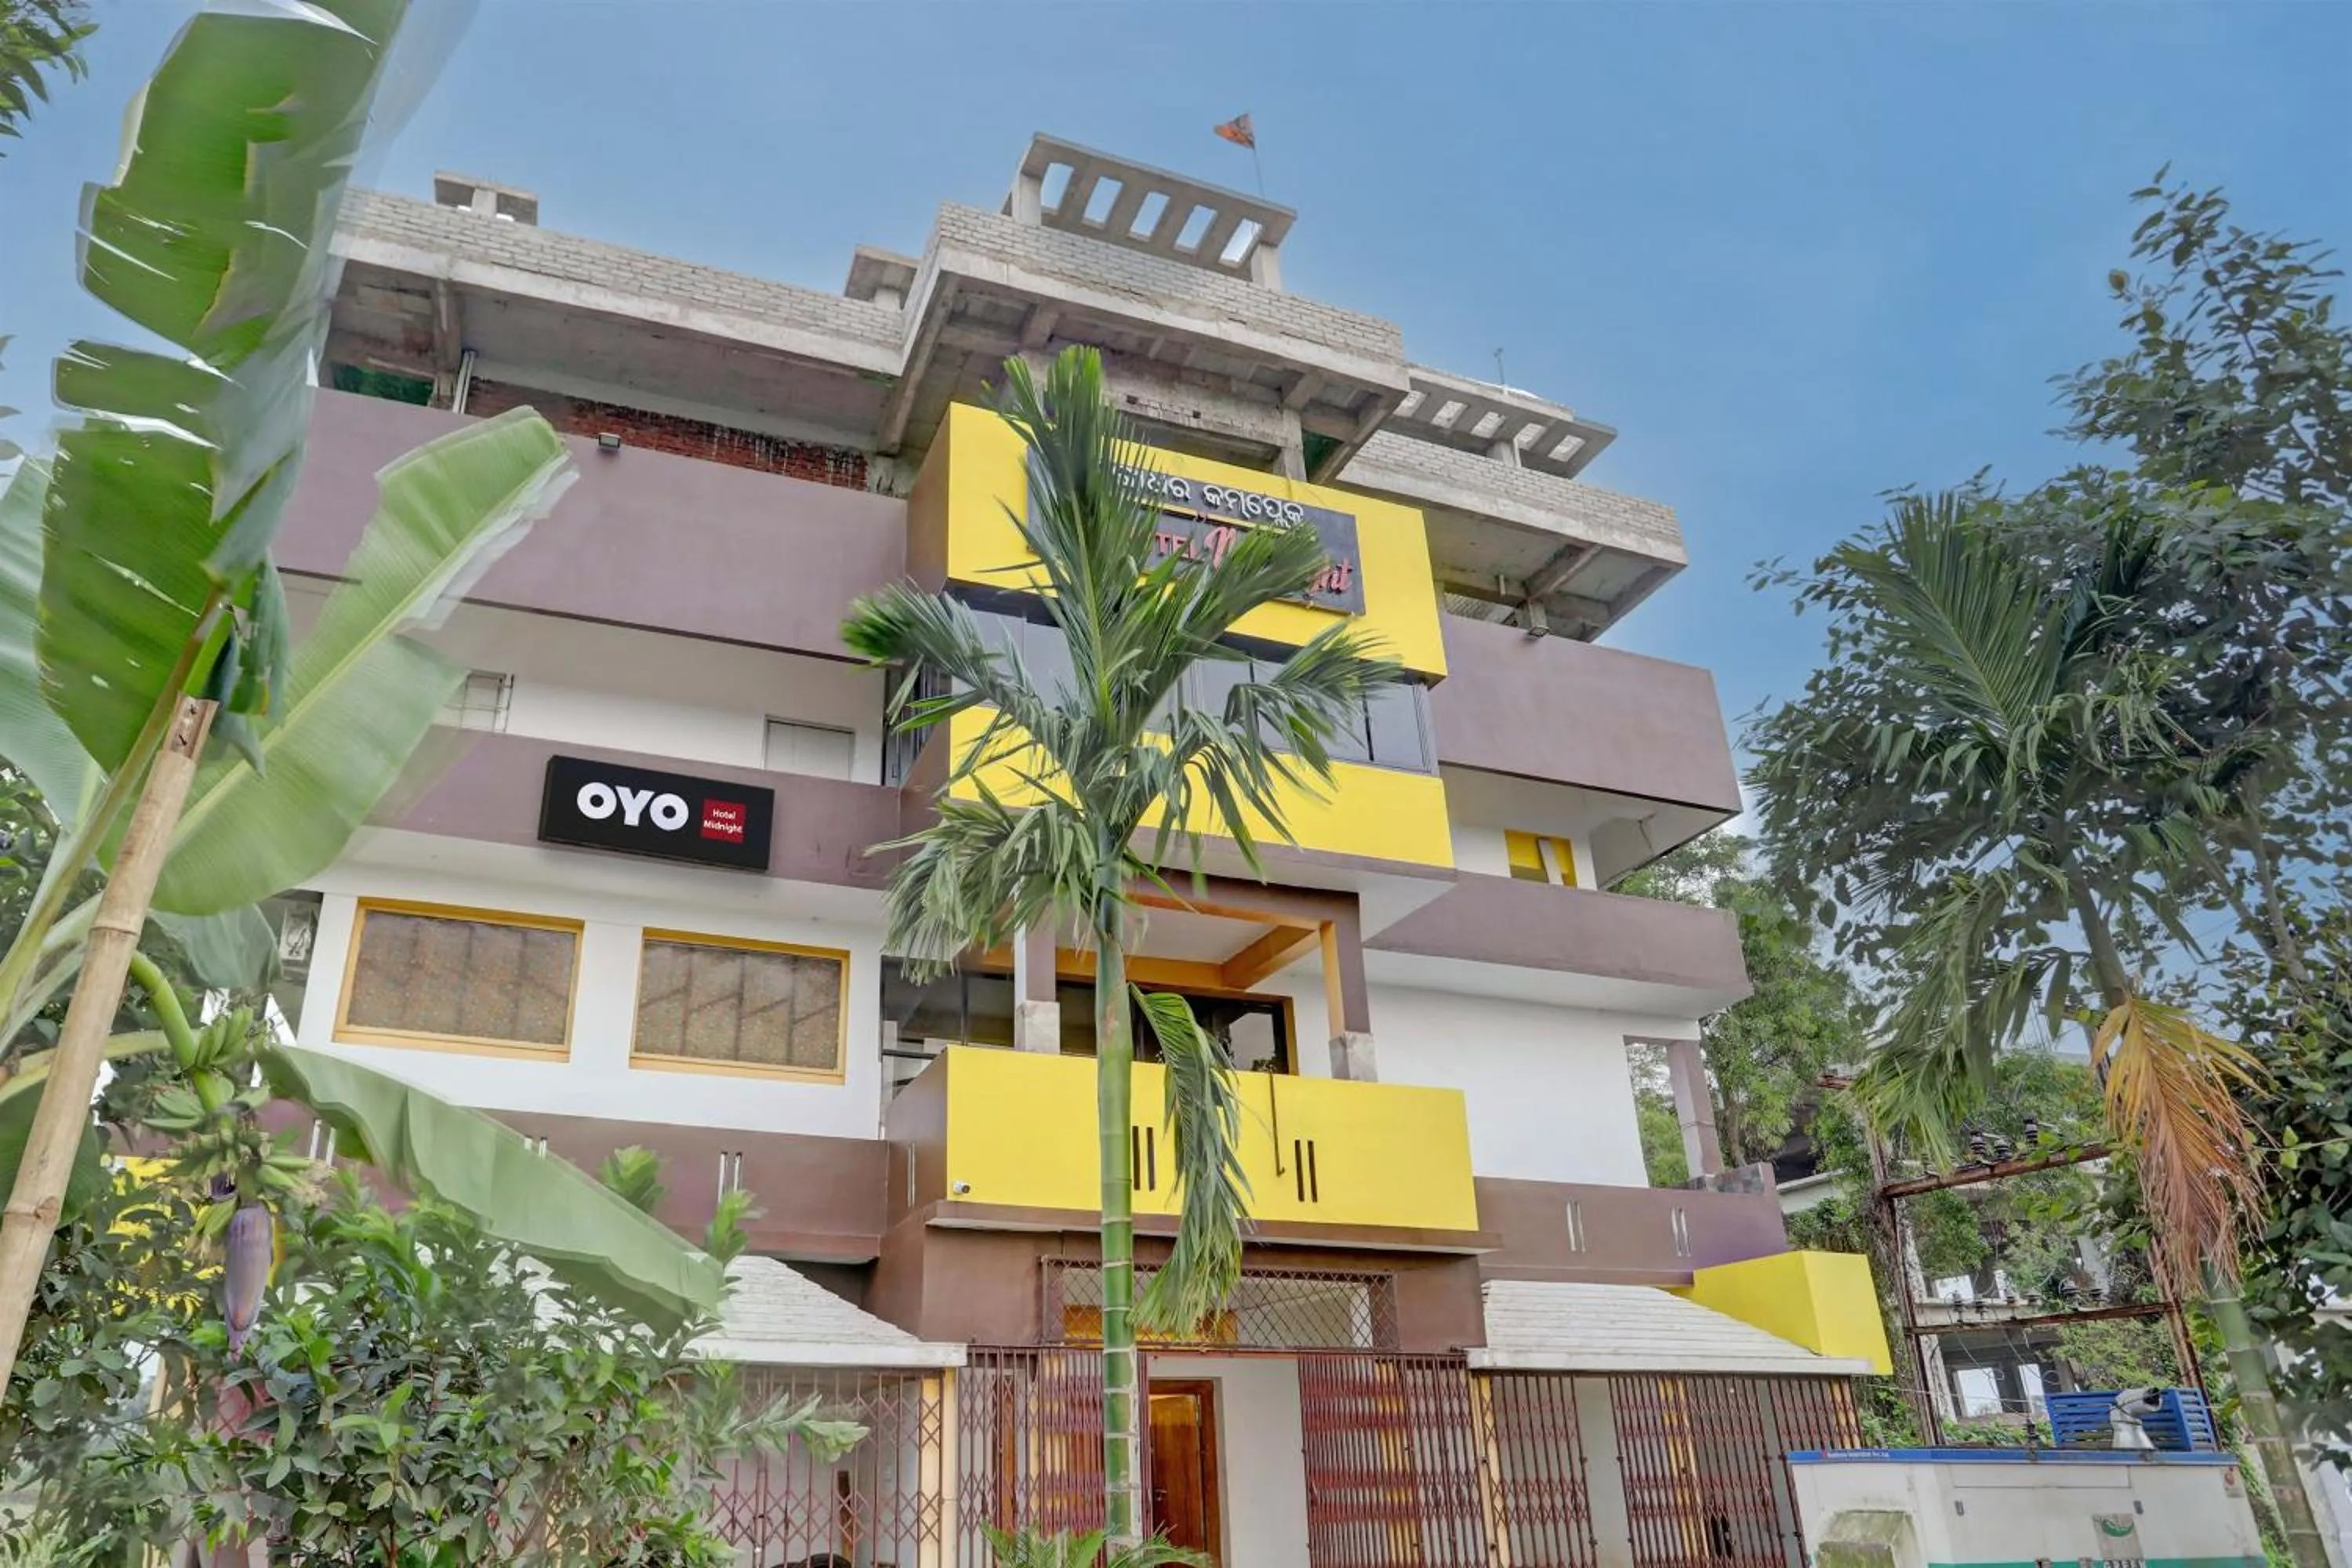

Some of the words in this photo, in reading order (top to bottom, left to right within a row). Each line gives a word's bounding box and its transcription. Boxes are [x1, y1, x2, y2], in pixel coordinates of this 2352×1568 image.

[577, 782, 690, 831] OYO
[712, 808, 736, 820] Hotel
[703, 820, 744, 834] Midnight
